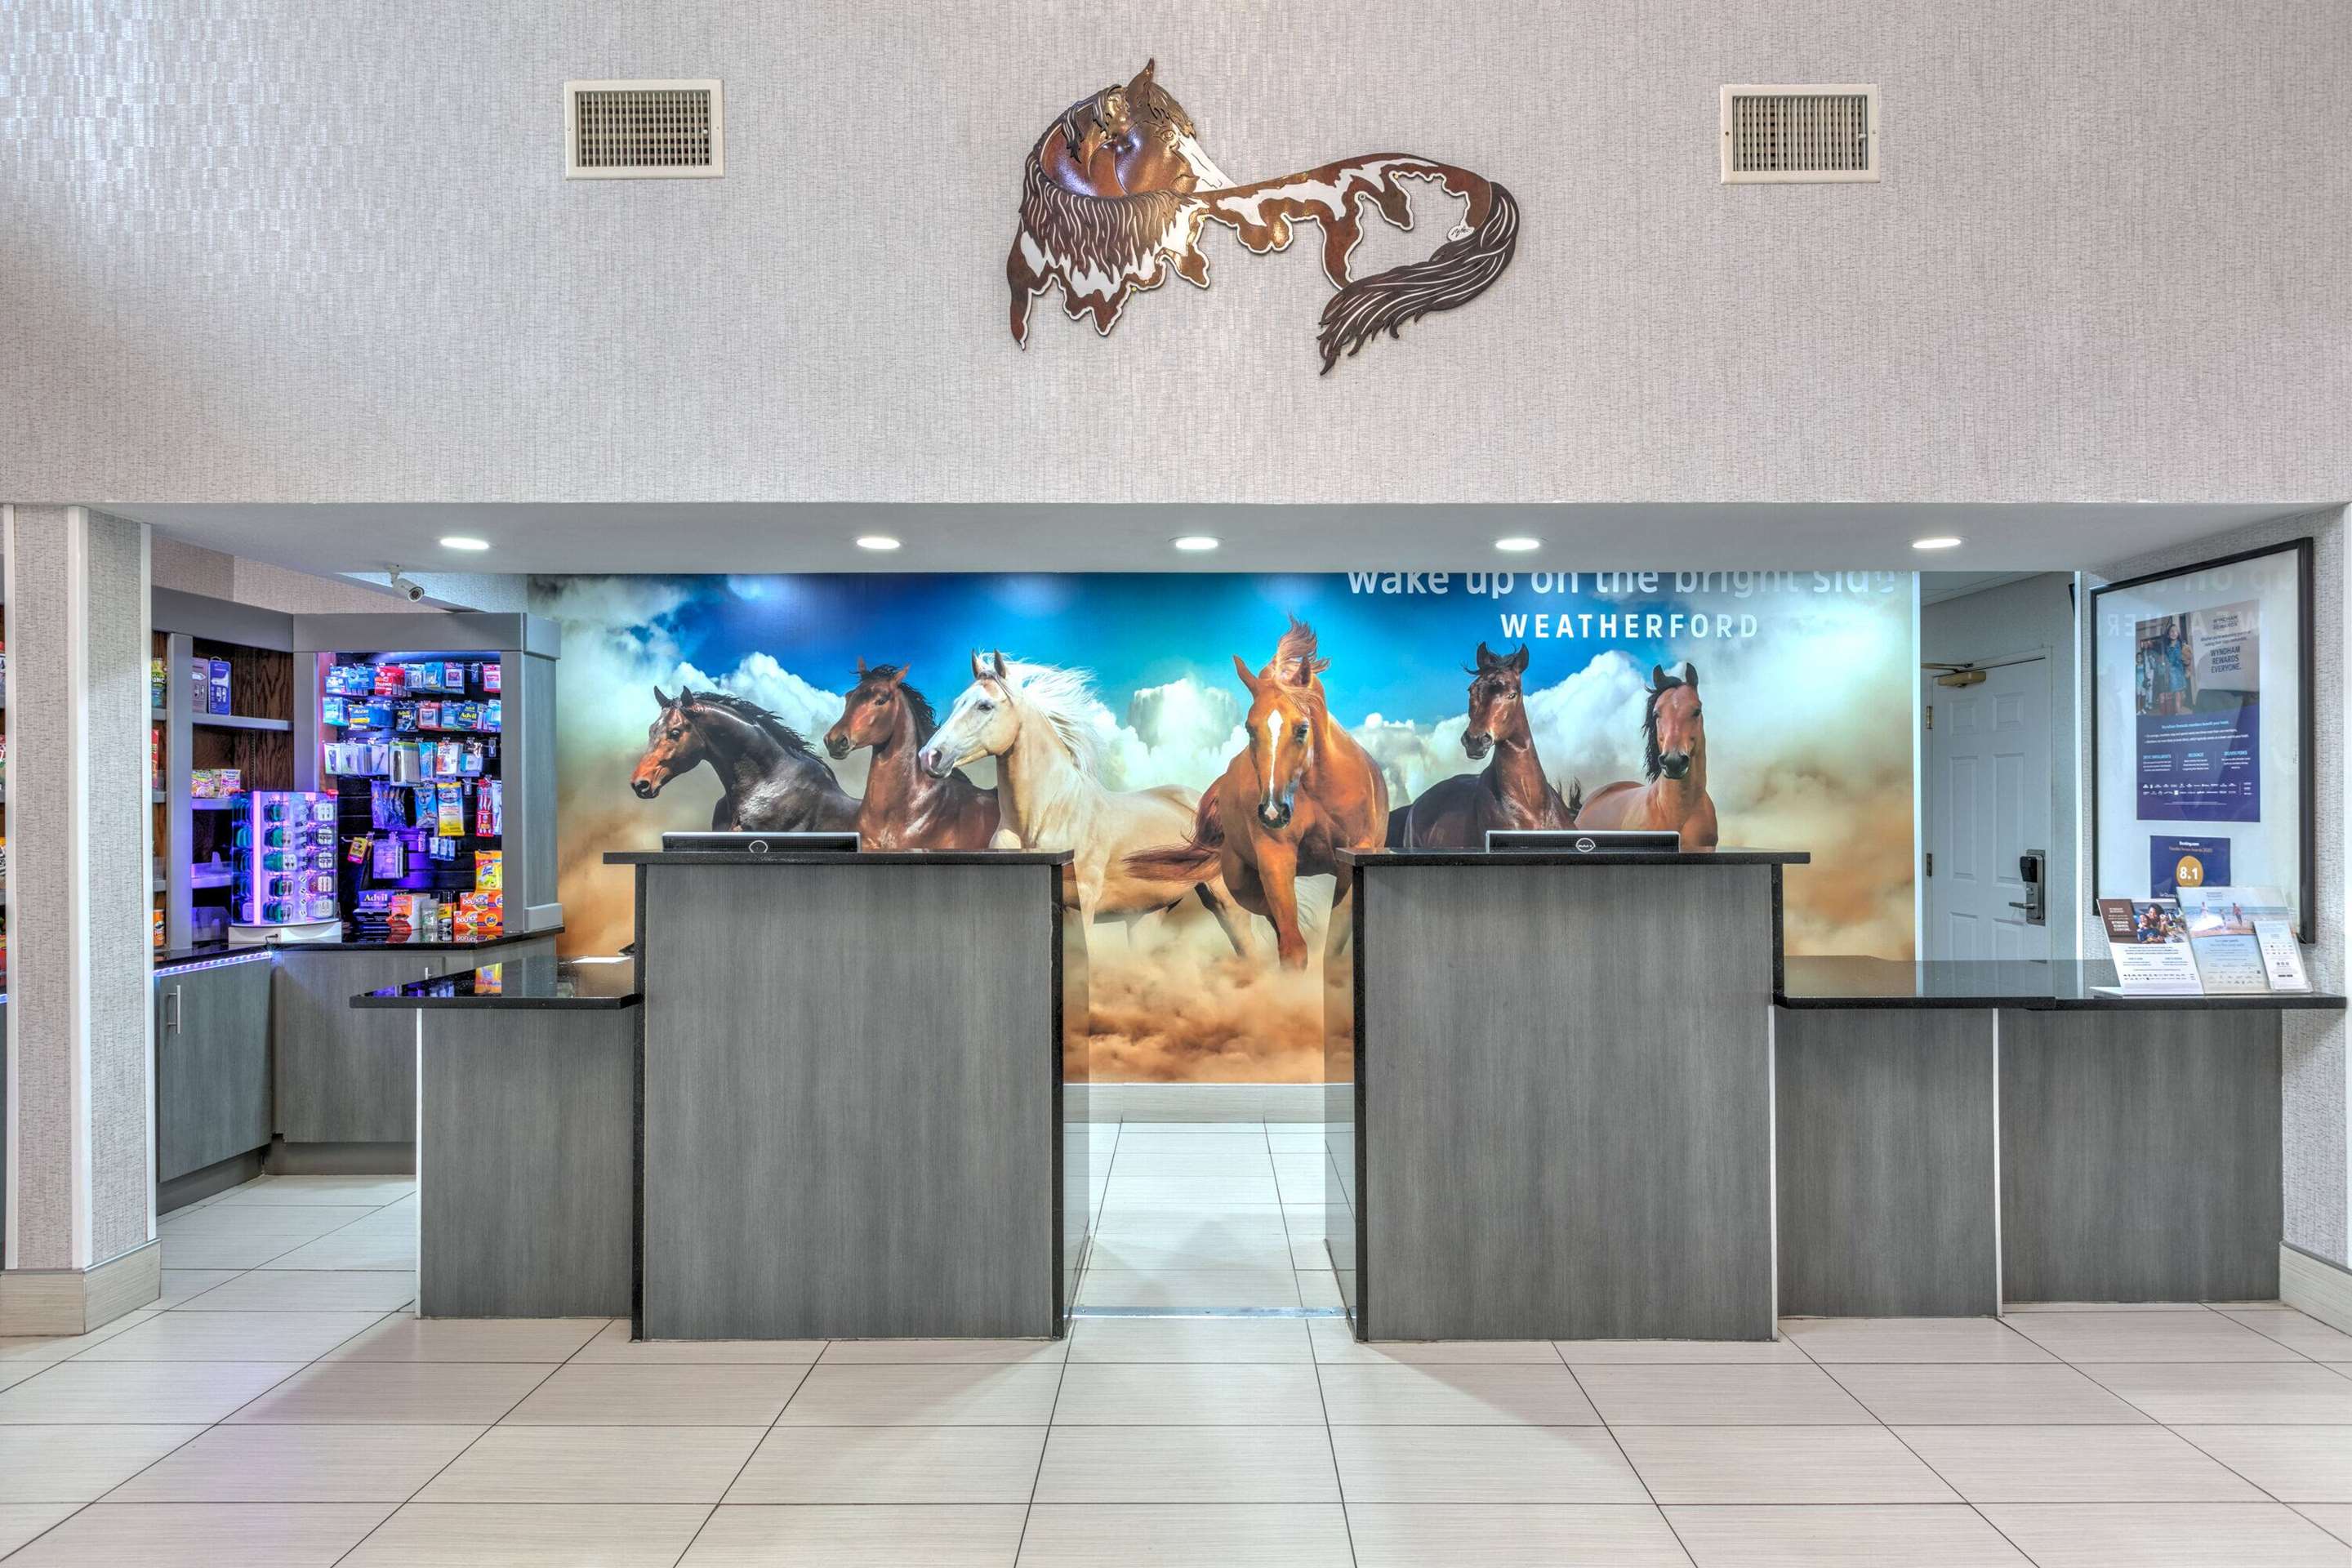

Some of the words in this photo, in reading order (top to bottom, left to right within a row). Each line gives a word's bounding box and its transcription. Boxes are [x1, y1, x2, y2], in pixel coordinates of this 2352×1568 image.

[1348, 572, 1450, 595] wake
[1466, 572, 1514, 599] up
[1530, 572, 1579, 594] on
[1500, 613, 1757, 639] WEATHERFORD
[2179, 866, 2198, 880] 8.1
[364, 893, 388, 902] Advil
